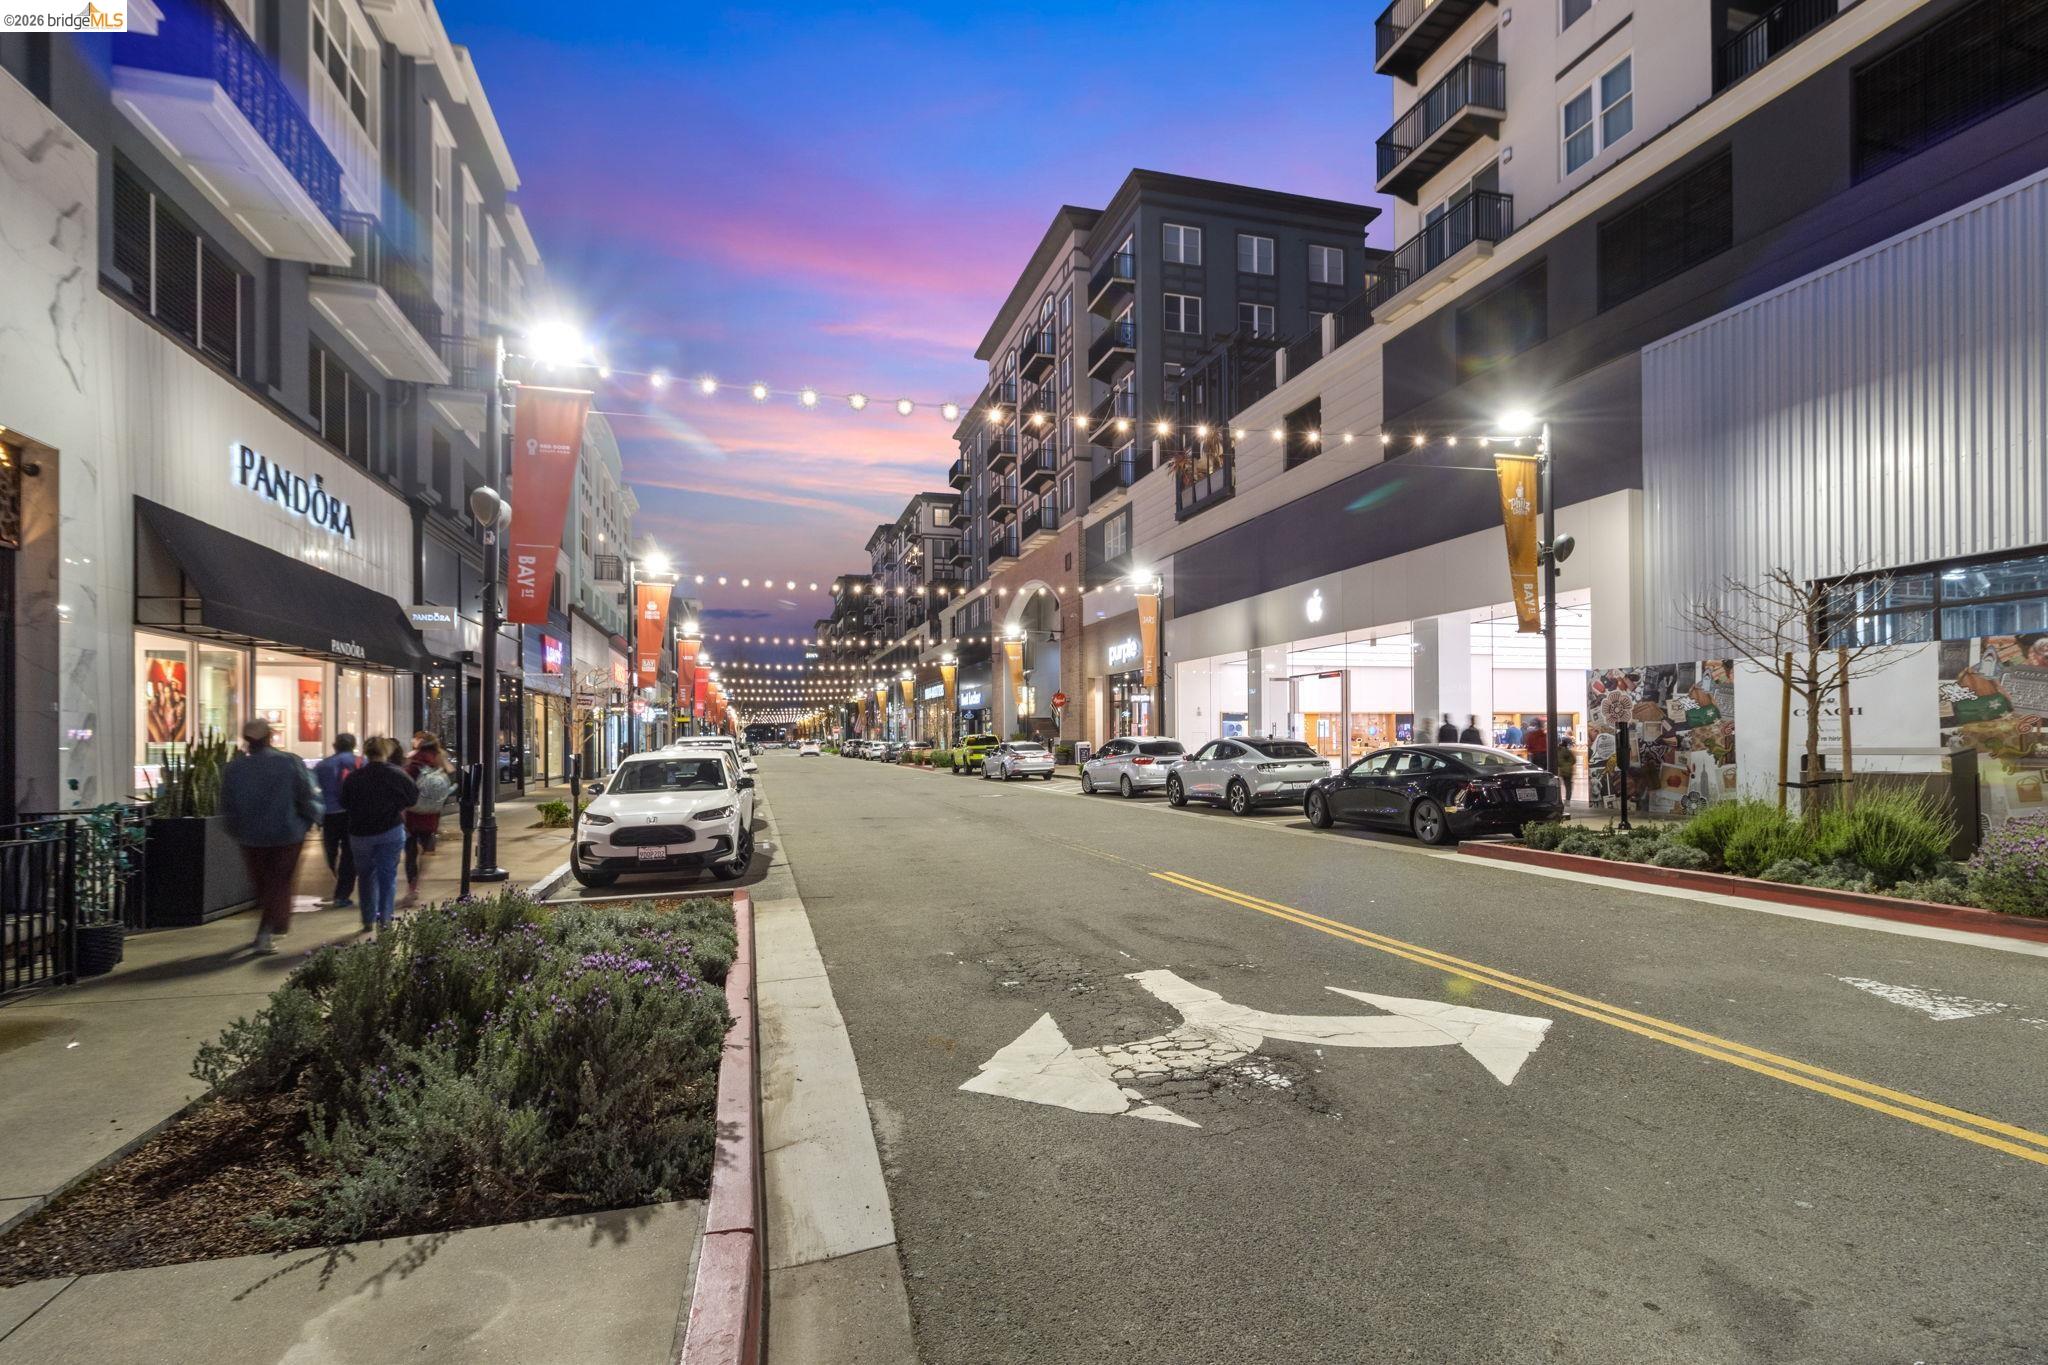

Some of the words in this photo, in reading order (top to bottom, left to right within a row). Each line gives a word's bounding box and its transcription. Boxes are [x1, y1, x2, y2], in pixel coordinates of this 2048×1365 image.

[240, 444, 355, 540] PANDORA
[516, 555, 537, 587] BAY
[1523, 583, 1534, 606] BAY
[331, 639, 365, 659] PANDORA
[1108, 638, 1138, 666] purple
